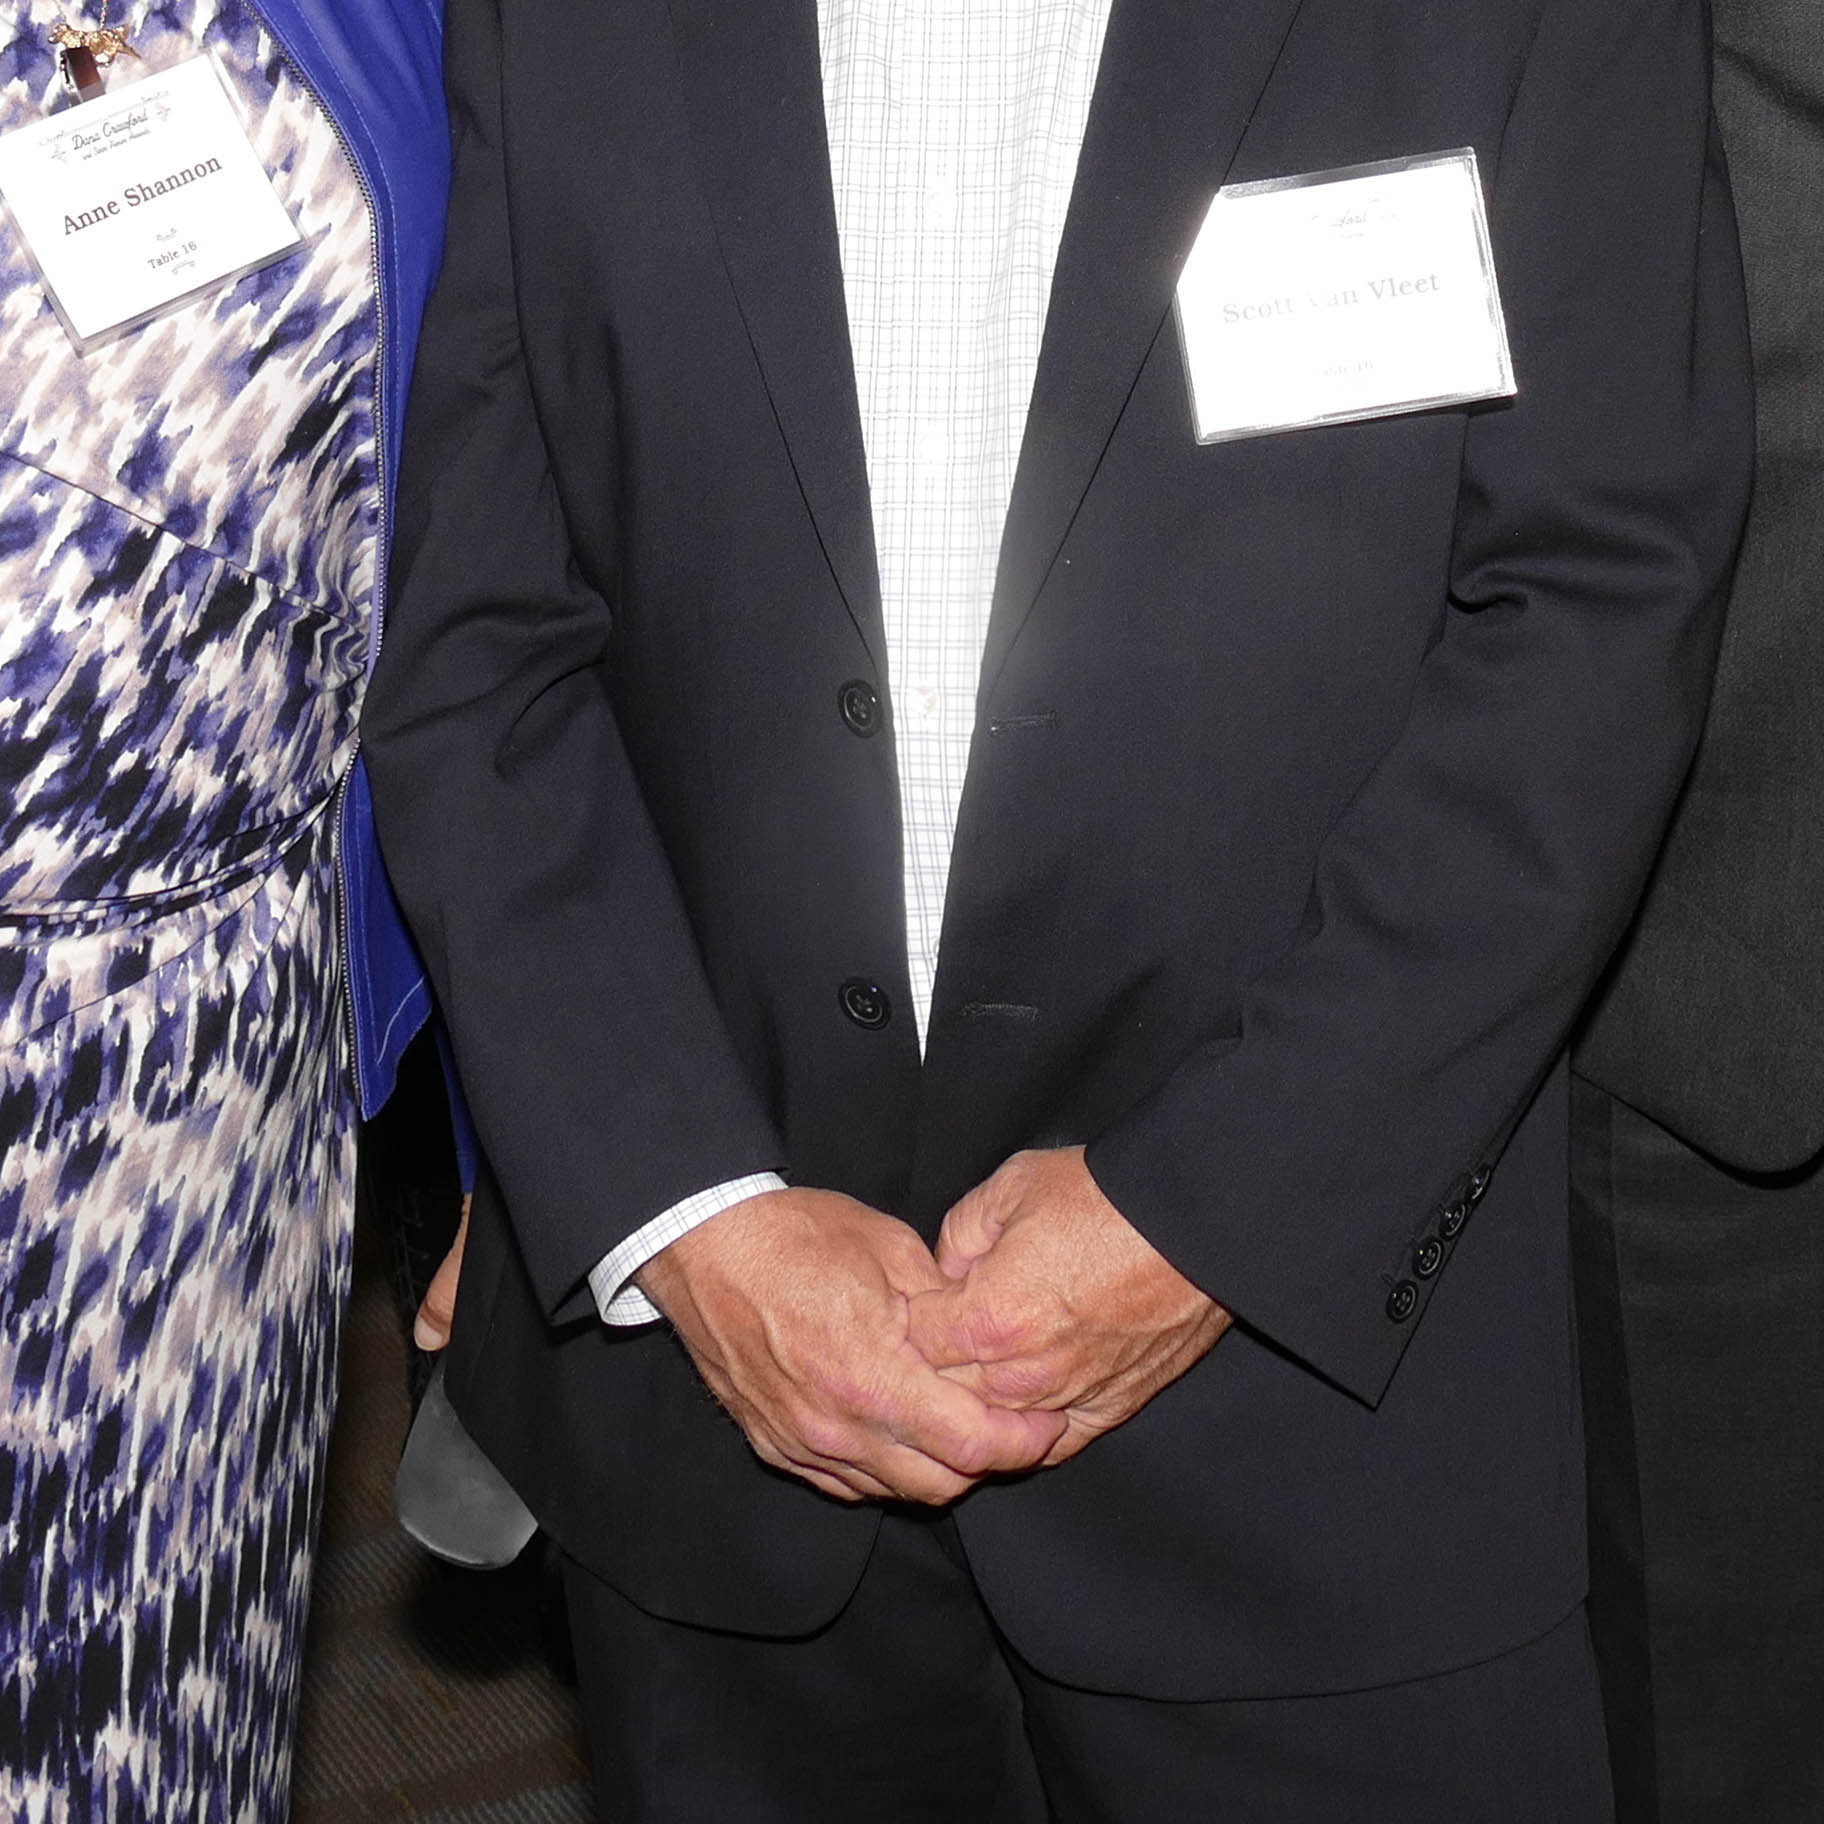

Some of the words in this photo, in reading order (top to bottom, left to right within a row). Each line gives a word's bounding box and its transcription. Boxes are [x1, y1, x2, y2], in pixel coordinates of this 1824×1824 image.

[64, 201, 121, 236] Anne
[124, 157, 223, 208] Shannon
[147, 249, 180, 269] Table
[183, 241, 198, 255] 16
[1223, 296, 1295, 324] Scott
[1368, 273, 1442, 301] Vleet
